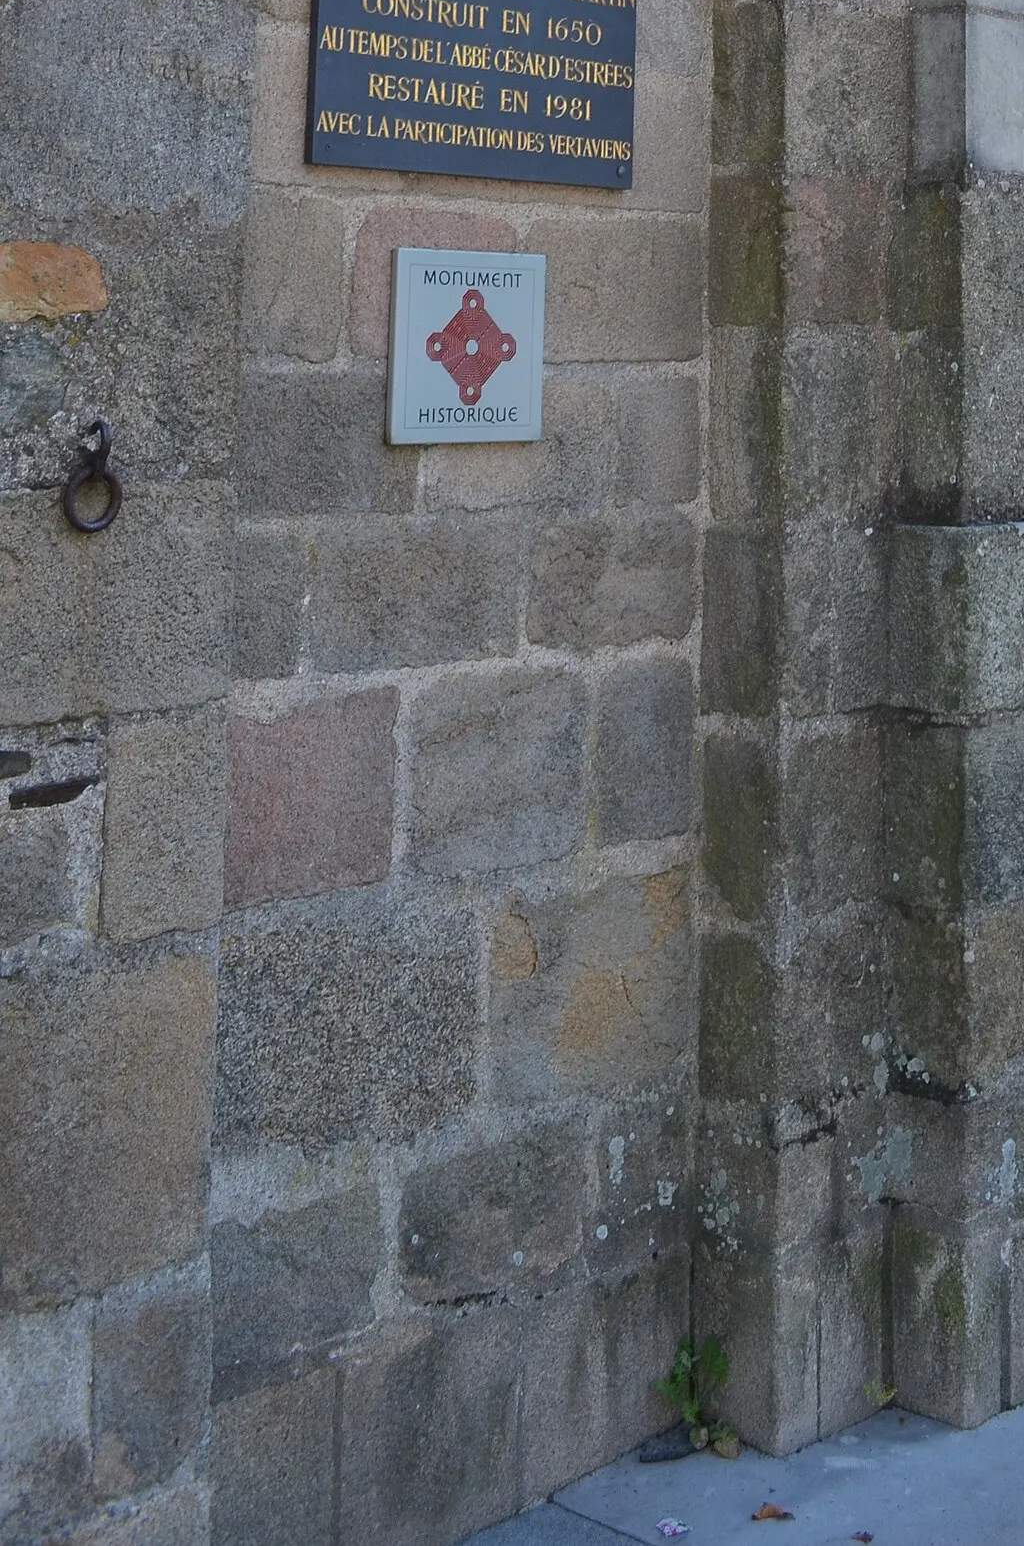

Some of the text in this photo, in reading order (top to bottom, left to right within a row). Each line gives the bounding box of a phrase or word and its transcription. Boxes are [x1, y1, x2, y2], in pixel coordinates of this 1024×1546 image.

[501, 8, 531, 36] EN
[547, 17, 602, 46] 1650
[319, 23, 345, 52] AU
[347, 28, 408, 60] TEMPS
[410, 37, 435, 63] DE
[494, 46, 548, 79] CÉSAR
[368, 72, 592, 121] RESTAURÉ EN 1981
[316, 109, 631, 161] AVEC LA PARTICIPATION DES VERTAVIENS
[423, 269, 523, 288] MONUMENT
[418, 406, 519, 424] HISTORIQUE
